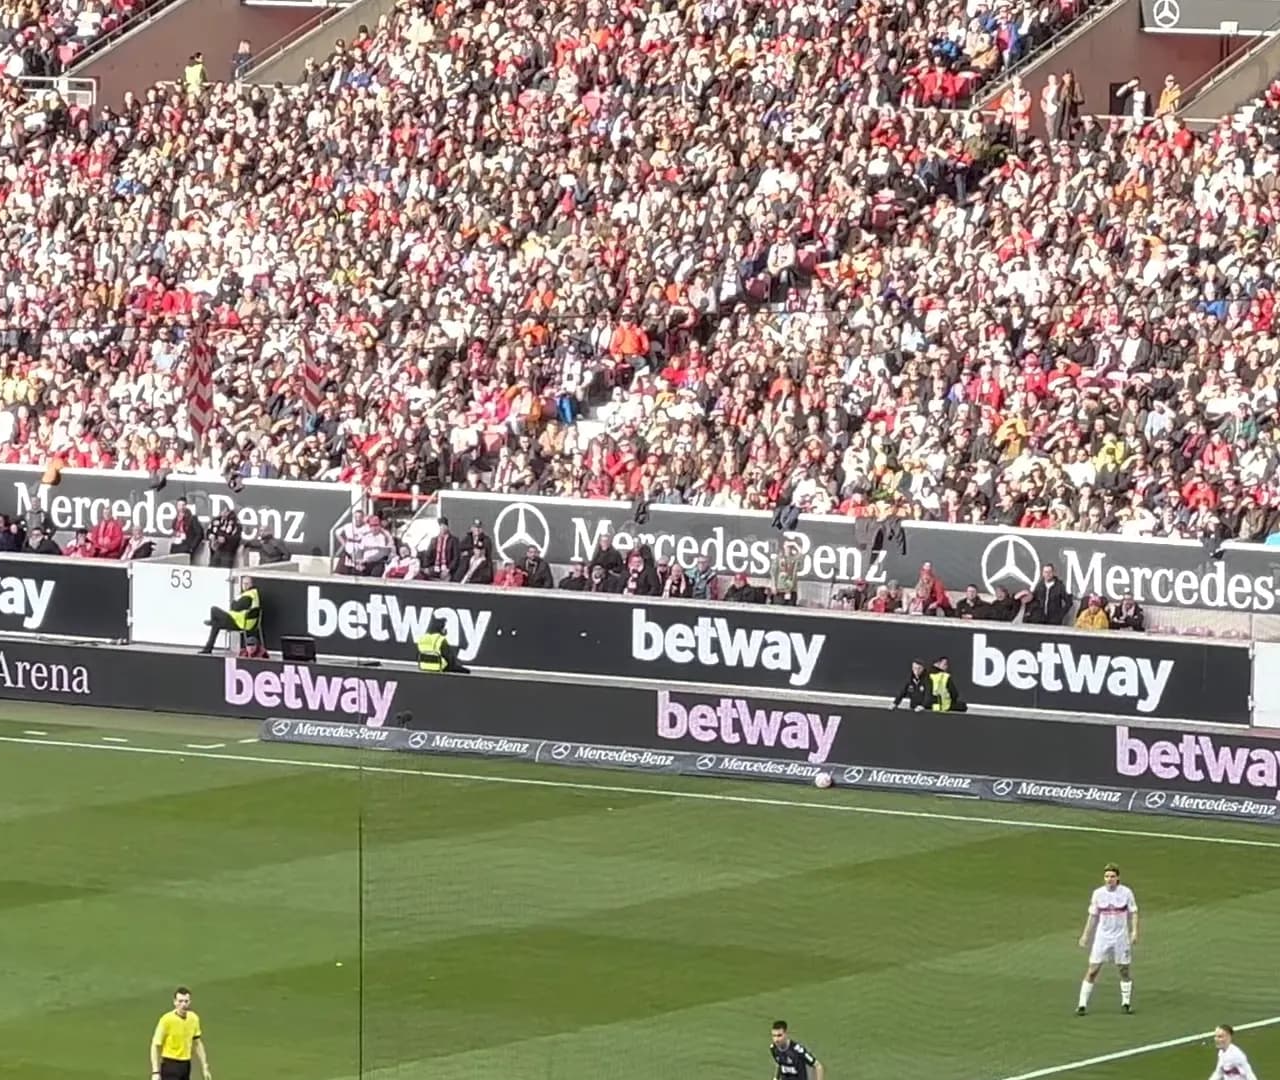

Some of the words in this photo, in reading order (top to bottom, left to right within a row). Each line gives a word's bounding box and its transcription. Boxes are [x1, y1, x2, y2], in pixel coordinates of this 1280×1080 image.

[170, 569, 192, 589] 53
[307, 585, 491, 661] betway
[631, 608, 825, 686] betway
[972, 633, 1174, 713] betway
[224, 657, 398, 728] betway
[657, 690, 842, 765] betway
[430, 734, 529, 754] Mercedes-Benz
[575, 746, 674, 766] Mercedes-Benz
[867, 769, 971, 789] Mercedes-Benz
[1018, 783, 1121, 802] Mercedes-Benz
[1170, 795, 1276, 816] Mercedes-Benz
